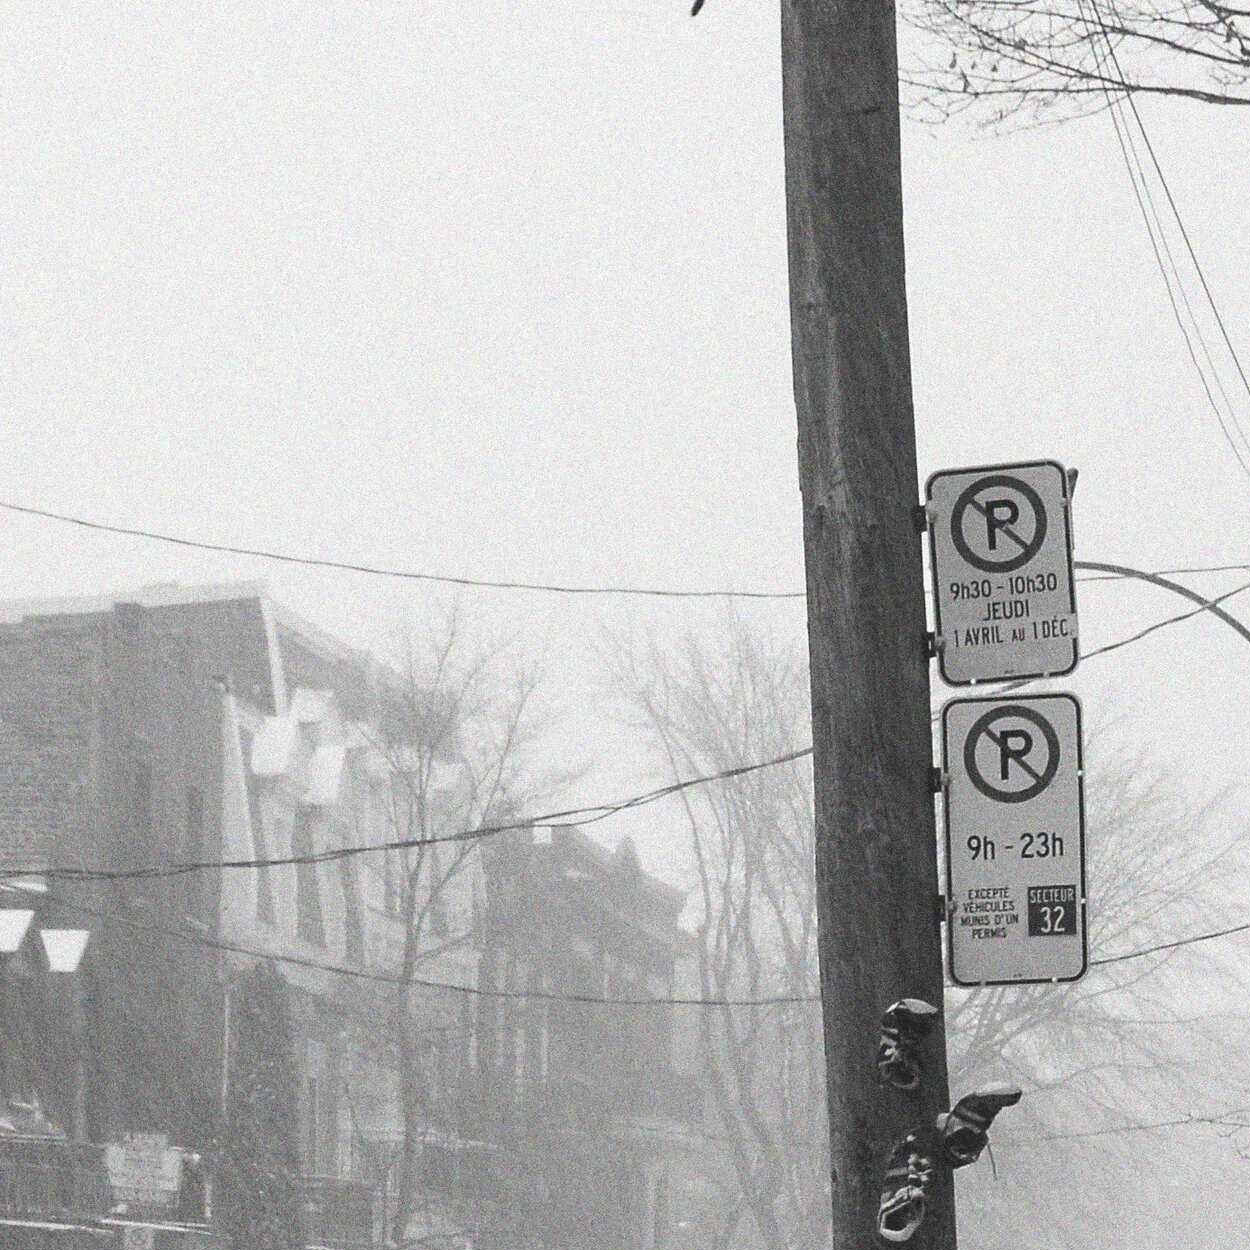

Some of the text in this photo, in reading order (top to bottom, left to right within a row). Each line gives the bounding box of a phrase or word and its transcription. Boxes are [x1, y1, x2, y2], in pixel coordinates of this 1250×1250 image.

[950, 579, 992, 600] 9h30
[1008, 573, 1058, 595] 10h30
[983, 599, 1030, 620] JEUDI
[954, 629, 960, 647] 1
[964, 626, 1004, 647] AVRIL
[1011, 628, 1026, 642] AU
[1032, 621, 1038, 640] 1
[967, 834, 996, 860] 9h
[1020, 831, 1065, 859] 23h
[1029, 887, 1075, 904] SECTEUR
[960, 915, 990, 927] MUNIS
[1040, 905, 1066, 934] 32
[972, 926, 1007, 940] PERMIS
